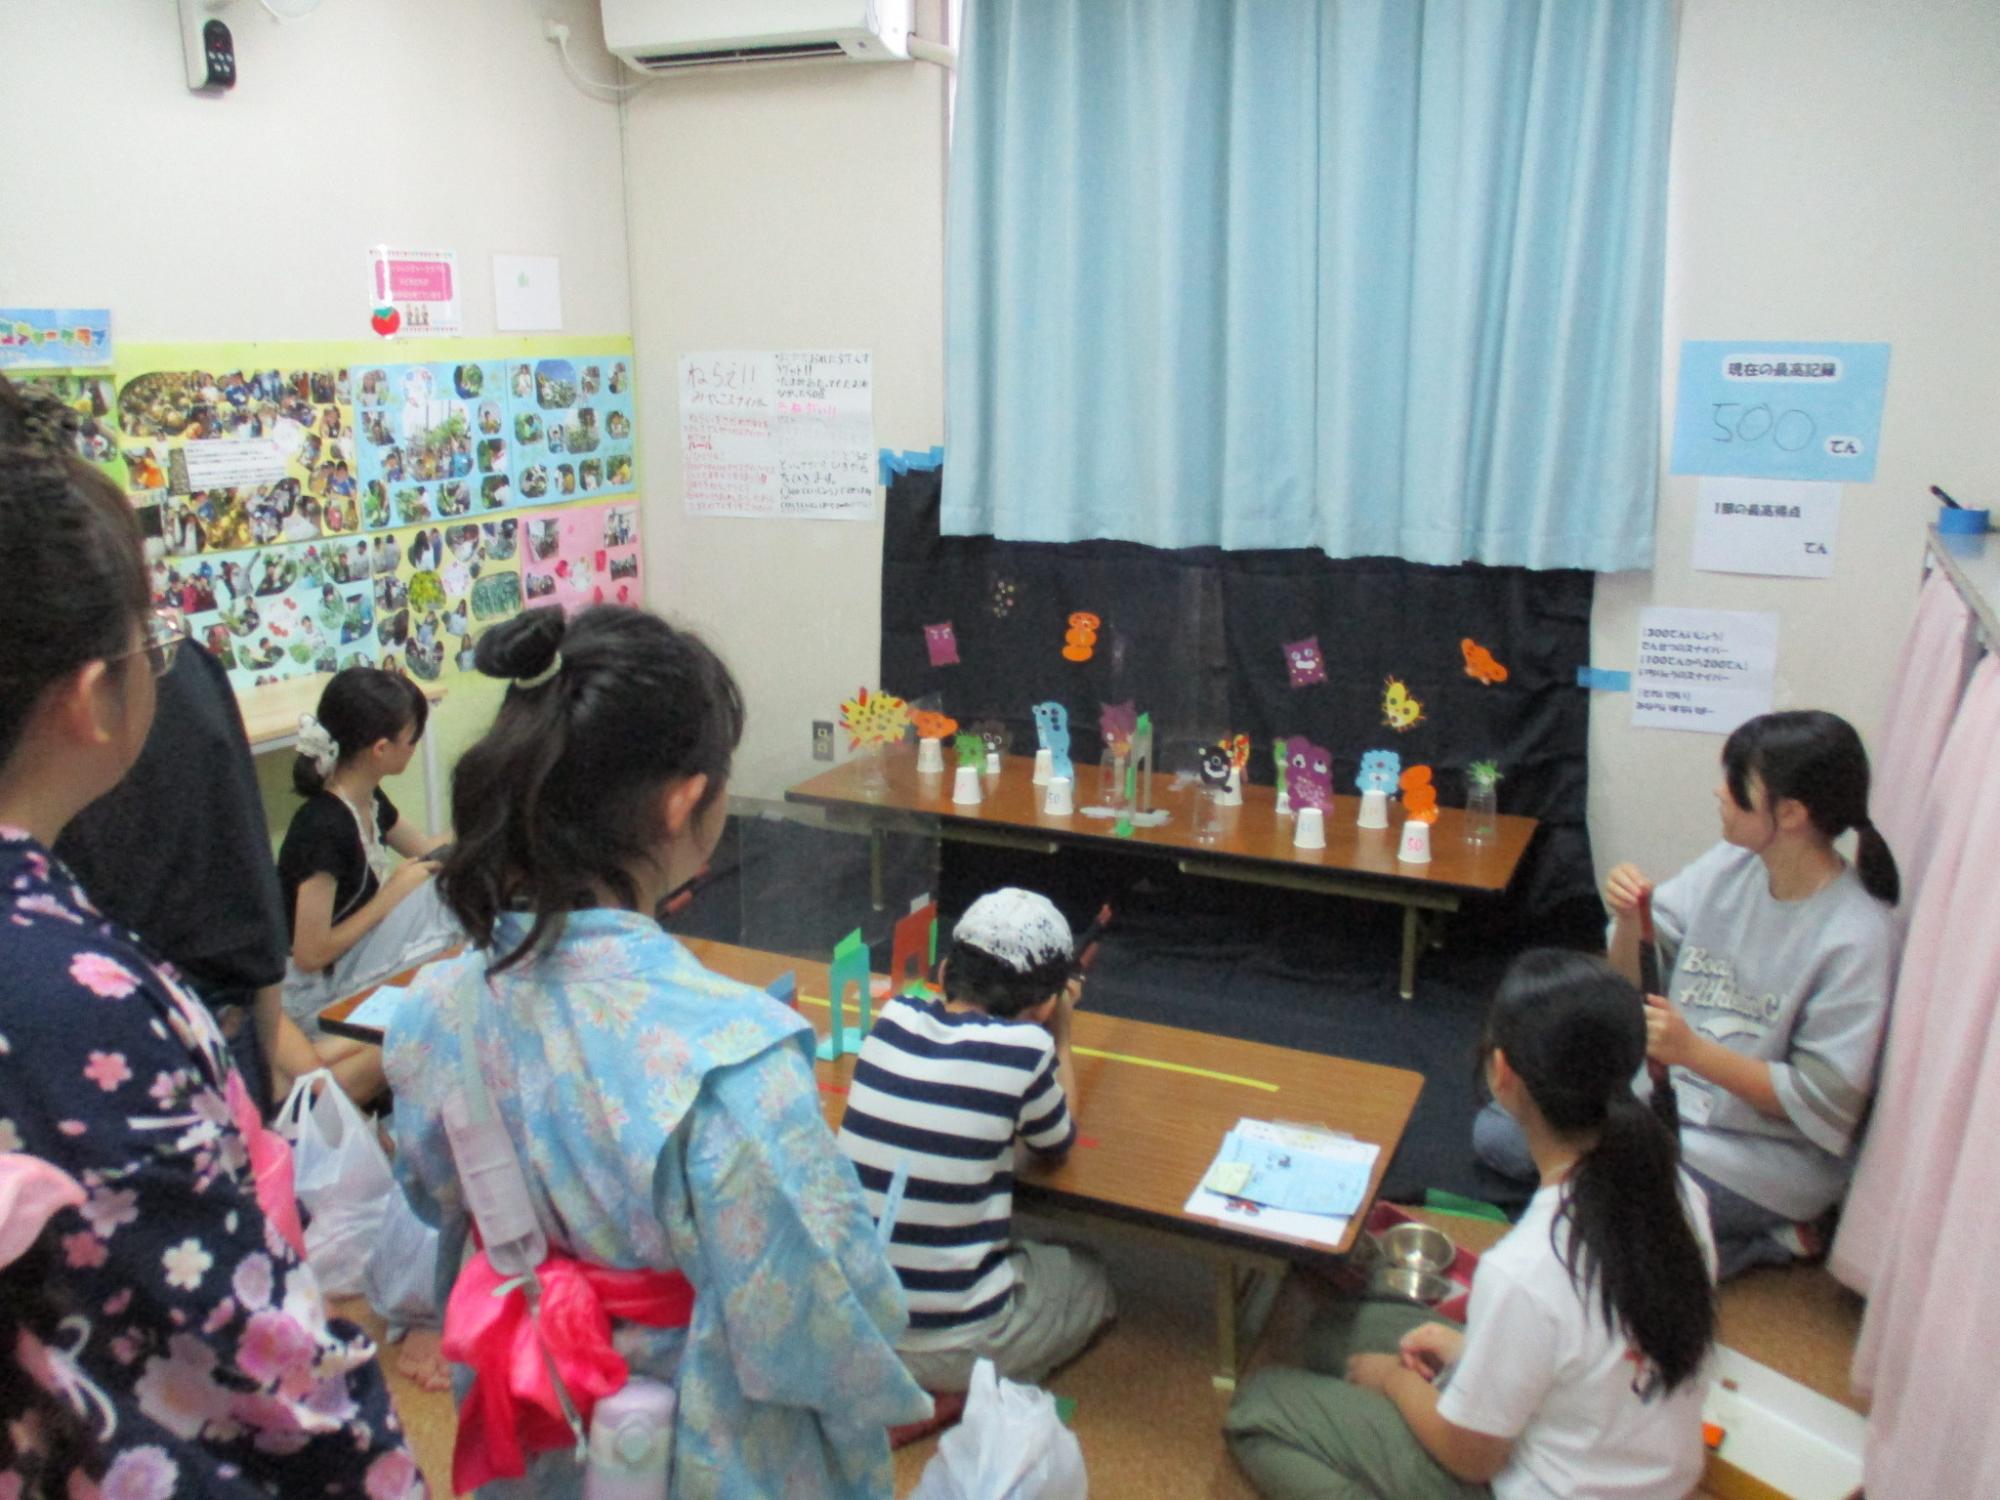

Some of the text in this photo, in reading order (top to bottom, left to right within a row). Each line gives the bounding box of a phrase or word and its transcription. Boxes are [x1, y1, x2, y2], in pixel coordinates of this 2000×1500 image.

[1711, 402, 1817, 452] 500
[1830, 440, 1859, 454] てん
[1804, 542, 1829, 555] てん
